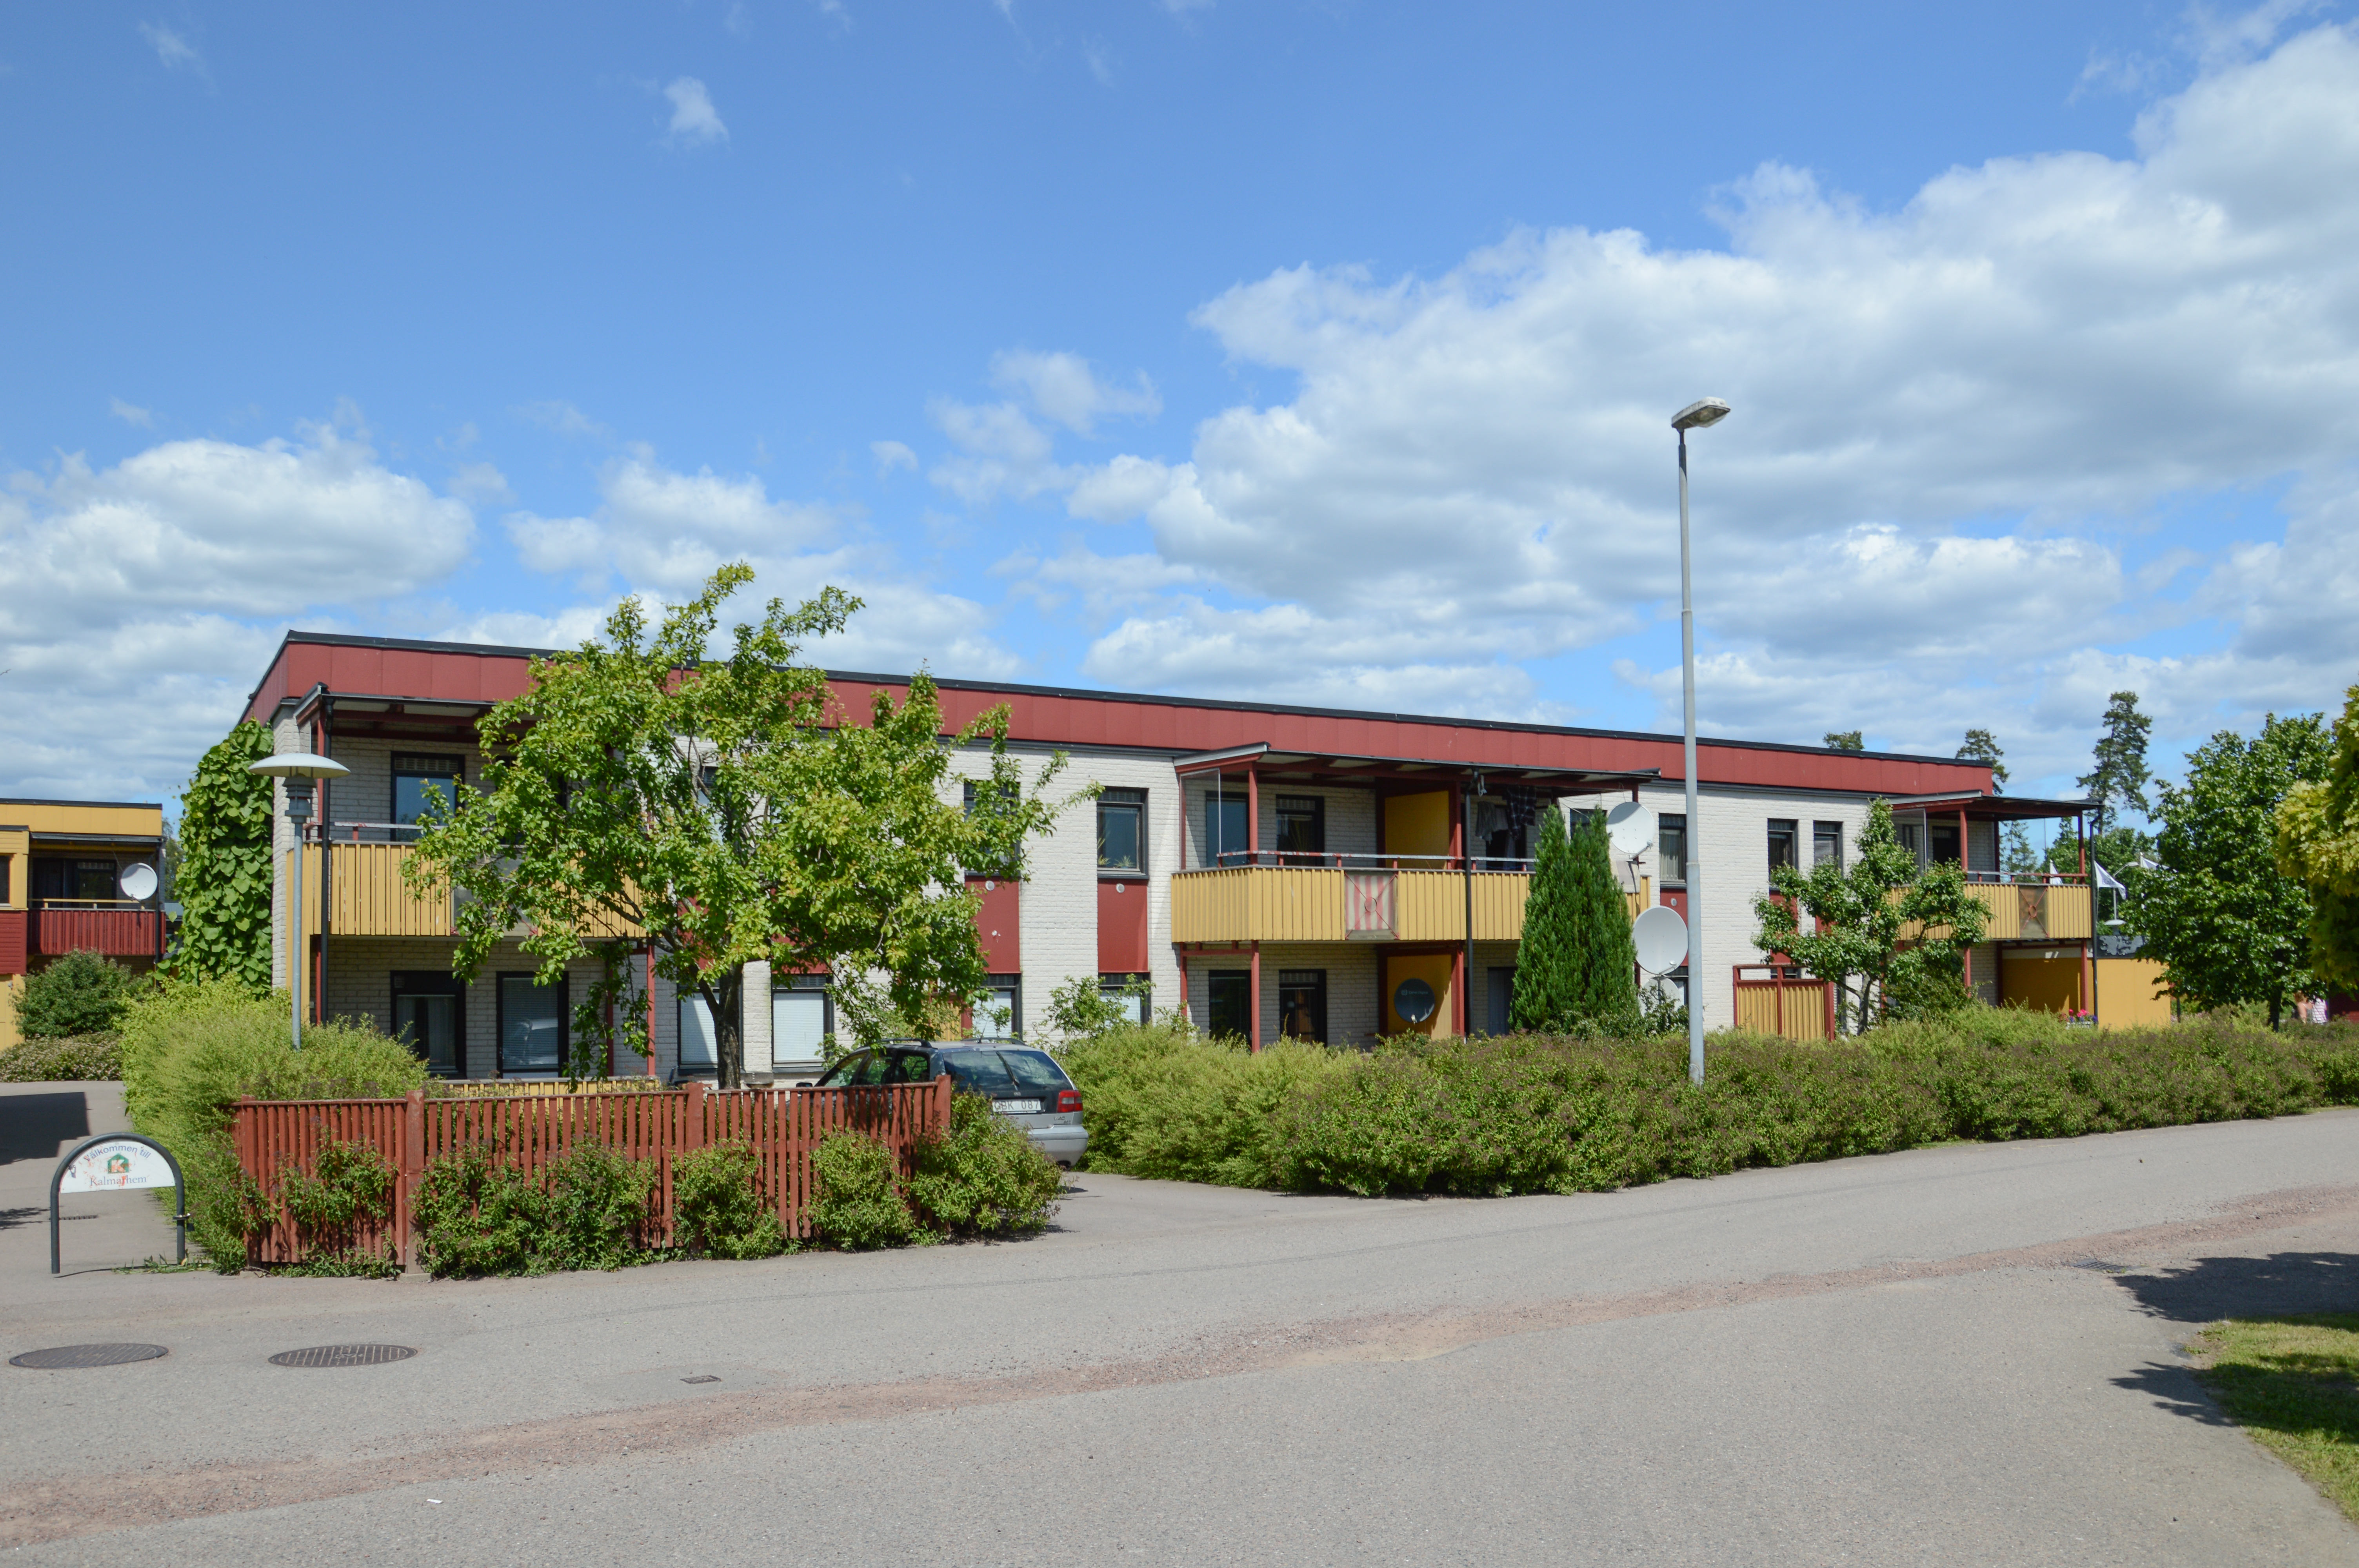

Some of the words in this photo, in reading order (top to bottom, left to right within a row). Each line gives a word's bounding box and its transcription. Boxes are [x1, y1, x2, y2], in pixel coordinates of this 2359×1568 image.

[1021, 1099, 1040, 1110] 087
[84, 1145, 138, 1161] Välkommen
[140, 1149, 151, 1159] till
